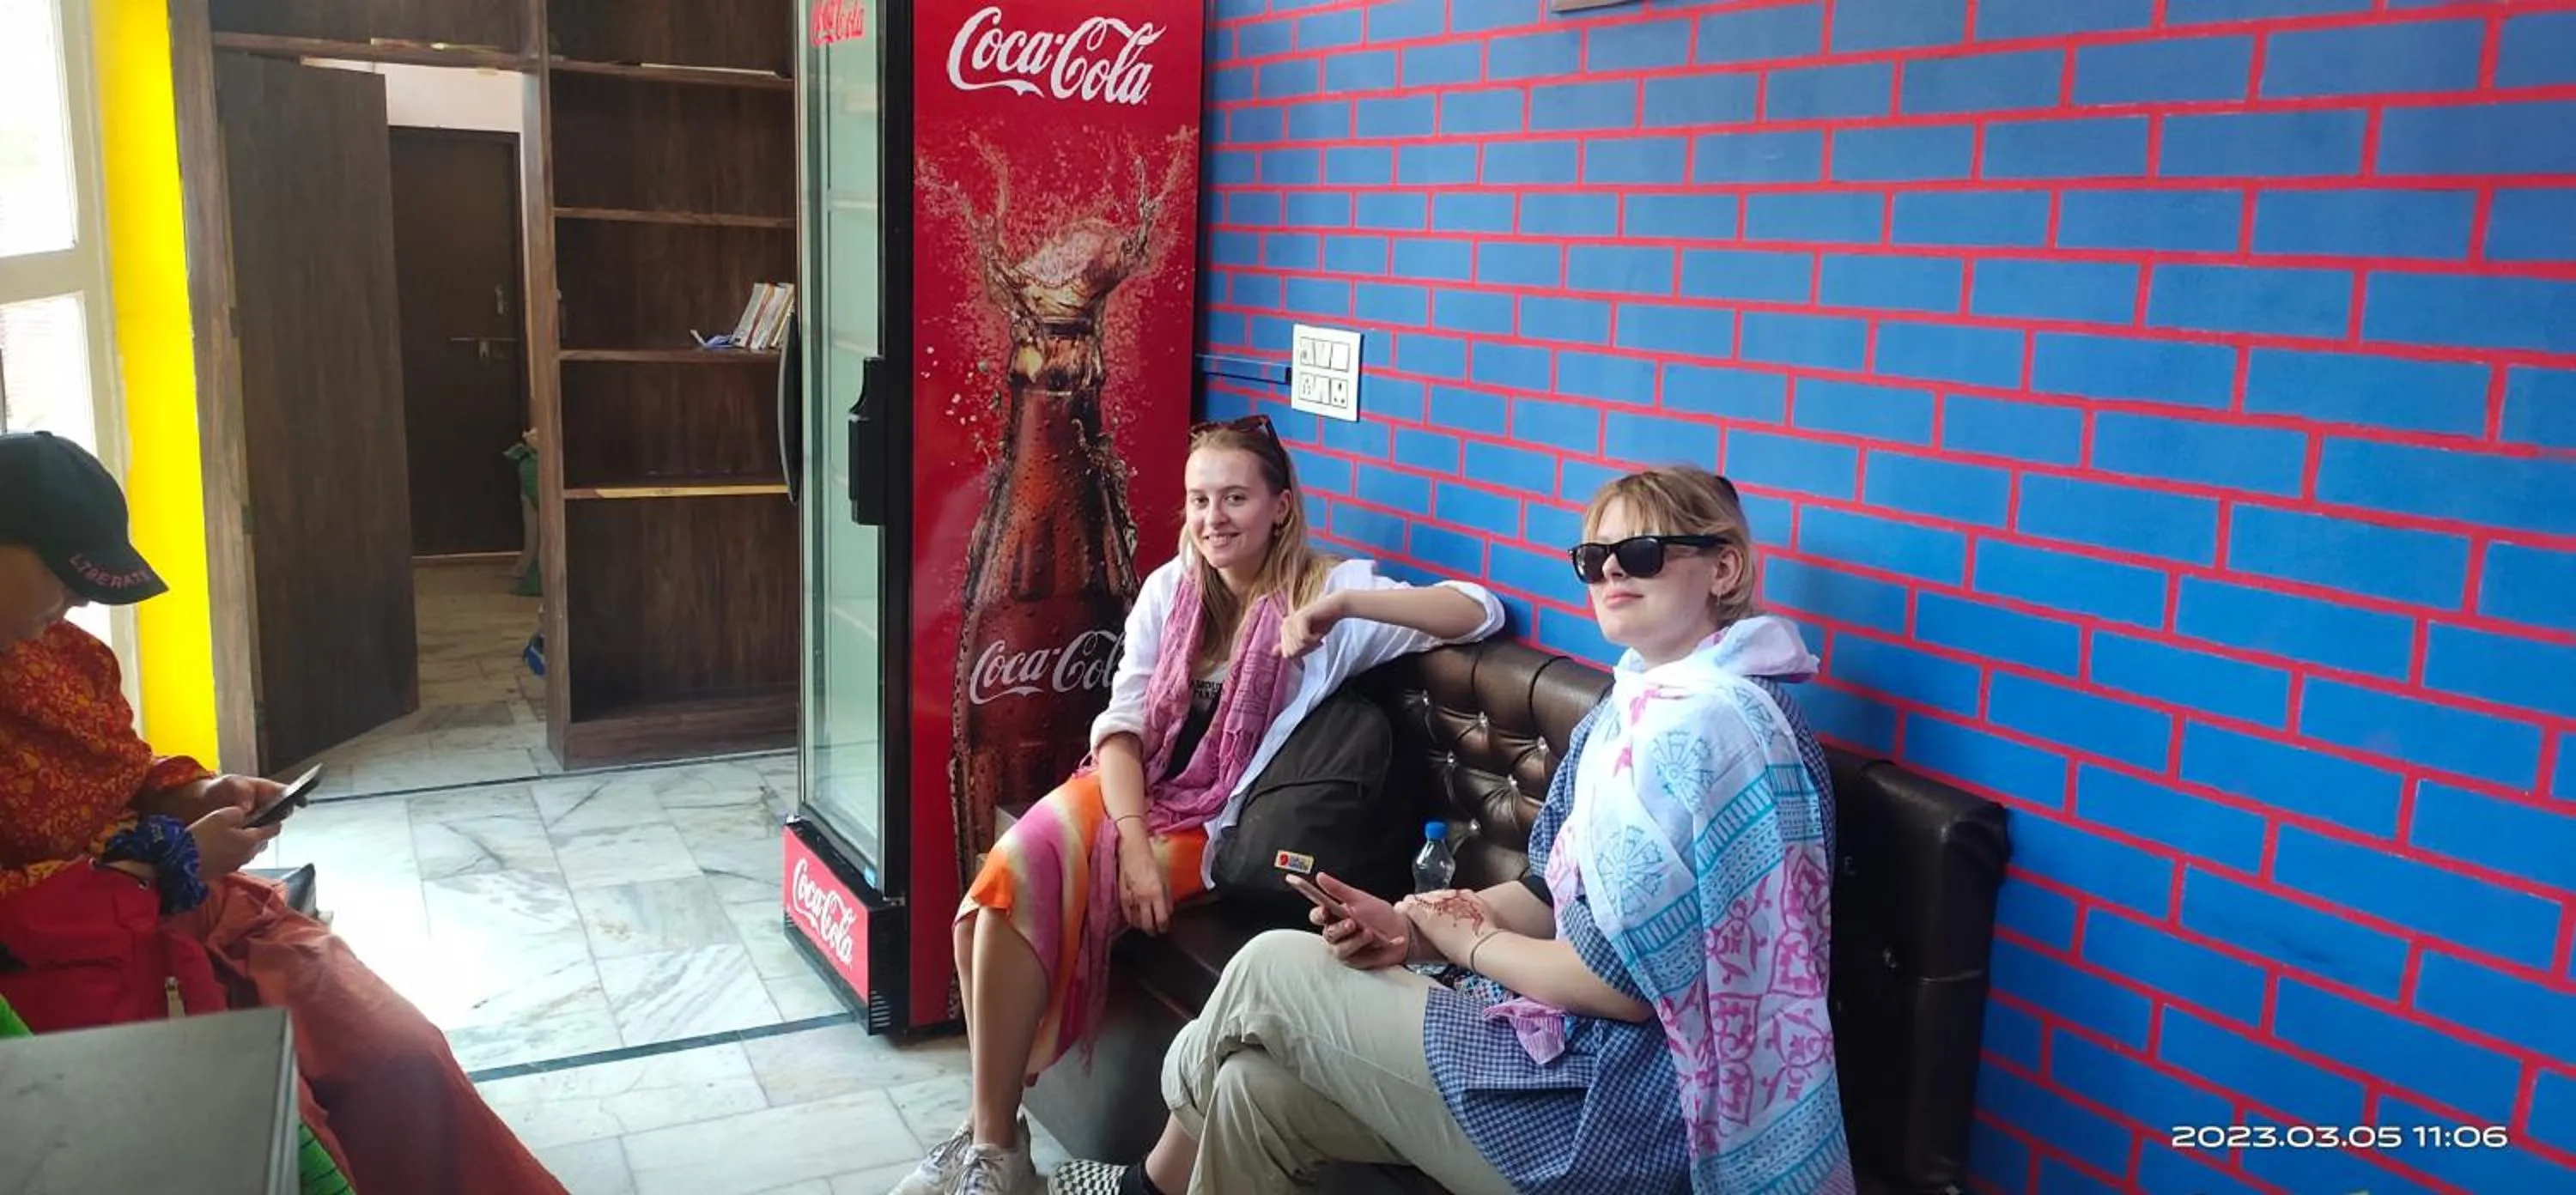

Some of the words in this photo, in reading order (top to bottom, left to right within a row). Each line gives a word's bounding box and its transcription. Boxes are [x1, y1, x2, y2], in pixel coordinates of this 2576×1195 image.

[947, 6, 1167, 106] Coca-Cola
[969, 629, 1127, 705] Coca-Col
[793, 858, 858, 966] Coca-Cola
